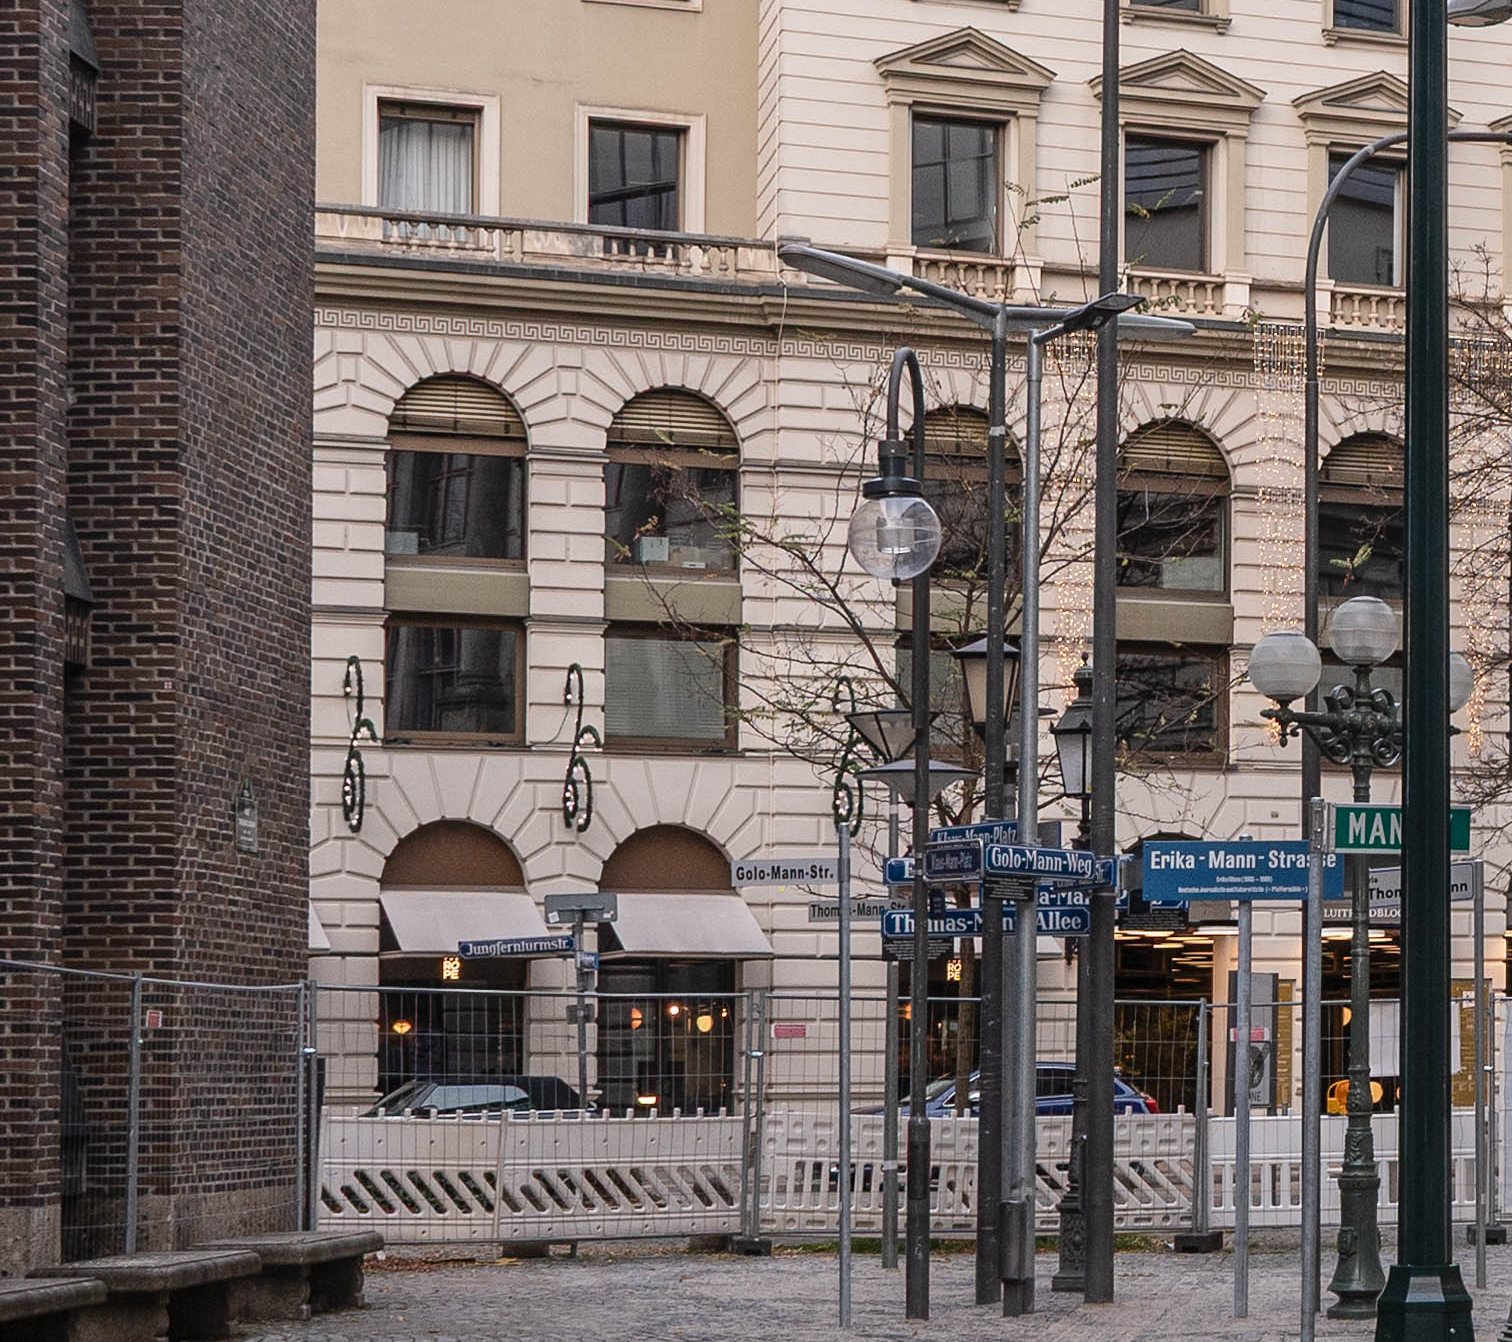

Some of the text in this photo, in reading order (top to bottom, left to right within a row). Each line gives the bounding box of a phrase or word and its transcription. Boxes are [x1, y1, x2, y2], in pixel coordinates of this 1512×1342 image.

[991, 847, 1092, 878] Golo-Mann-Weg
[1150, 850, 1195, 869] Erika
[1208, 850, 1256, 869] Mann
[736, 864, 834, 881] Golo-Mann-Str.
